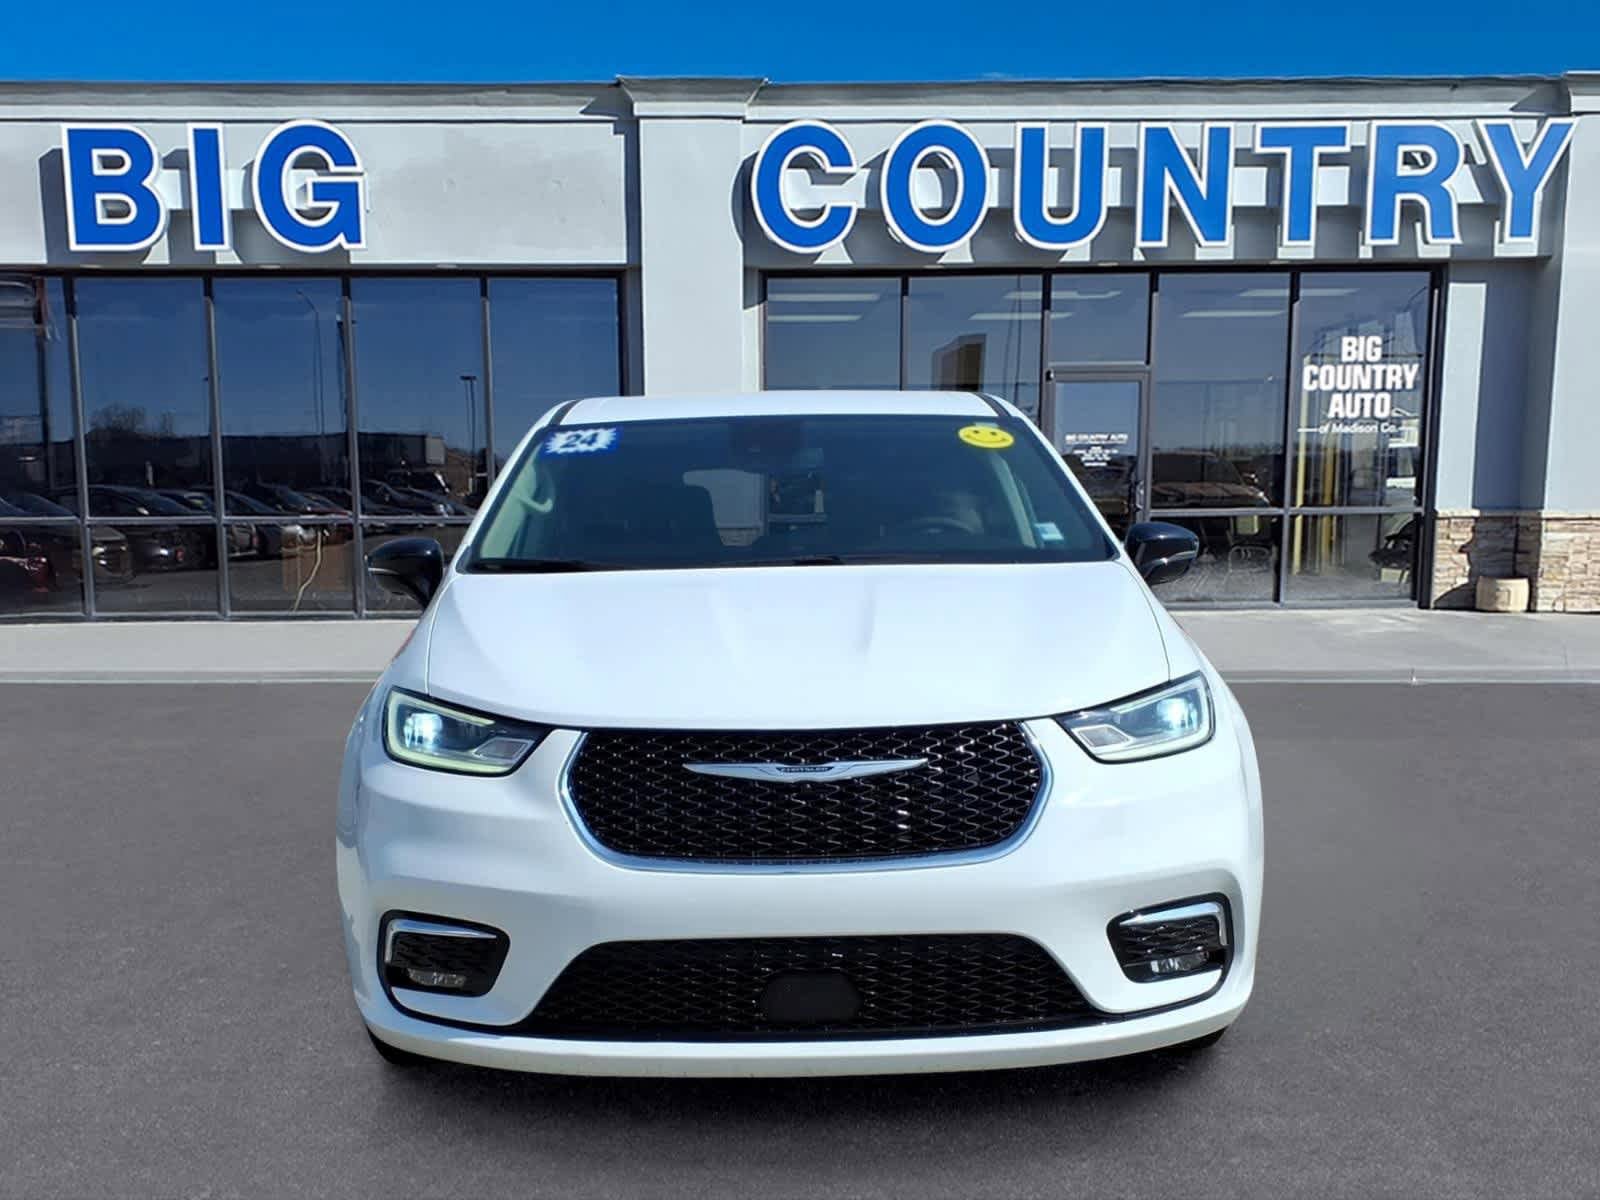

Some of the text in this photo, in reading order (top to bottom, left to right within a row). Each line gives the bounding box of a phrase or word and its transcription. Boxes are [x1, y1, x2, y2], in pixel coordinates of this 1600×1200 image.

[60, 118, 1577, 254] BIG COUNTRY
[1341, 335, 1382, 362] BIG
[1302, 363, 1420, 391] COUNTRY
[1327, 392, 1392, 419] AUTO
[1319, 421, 1330, 434] of
[1331, 421, 1378, 433] Madison
